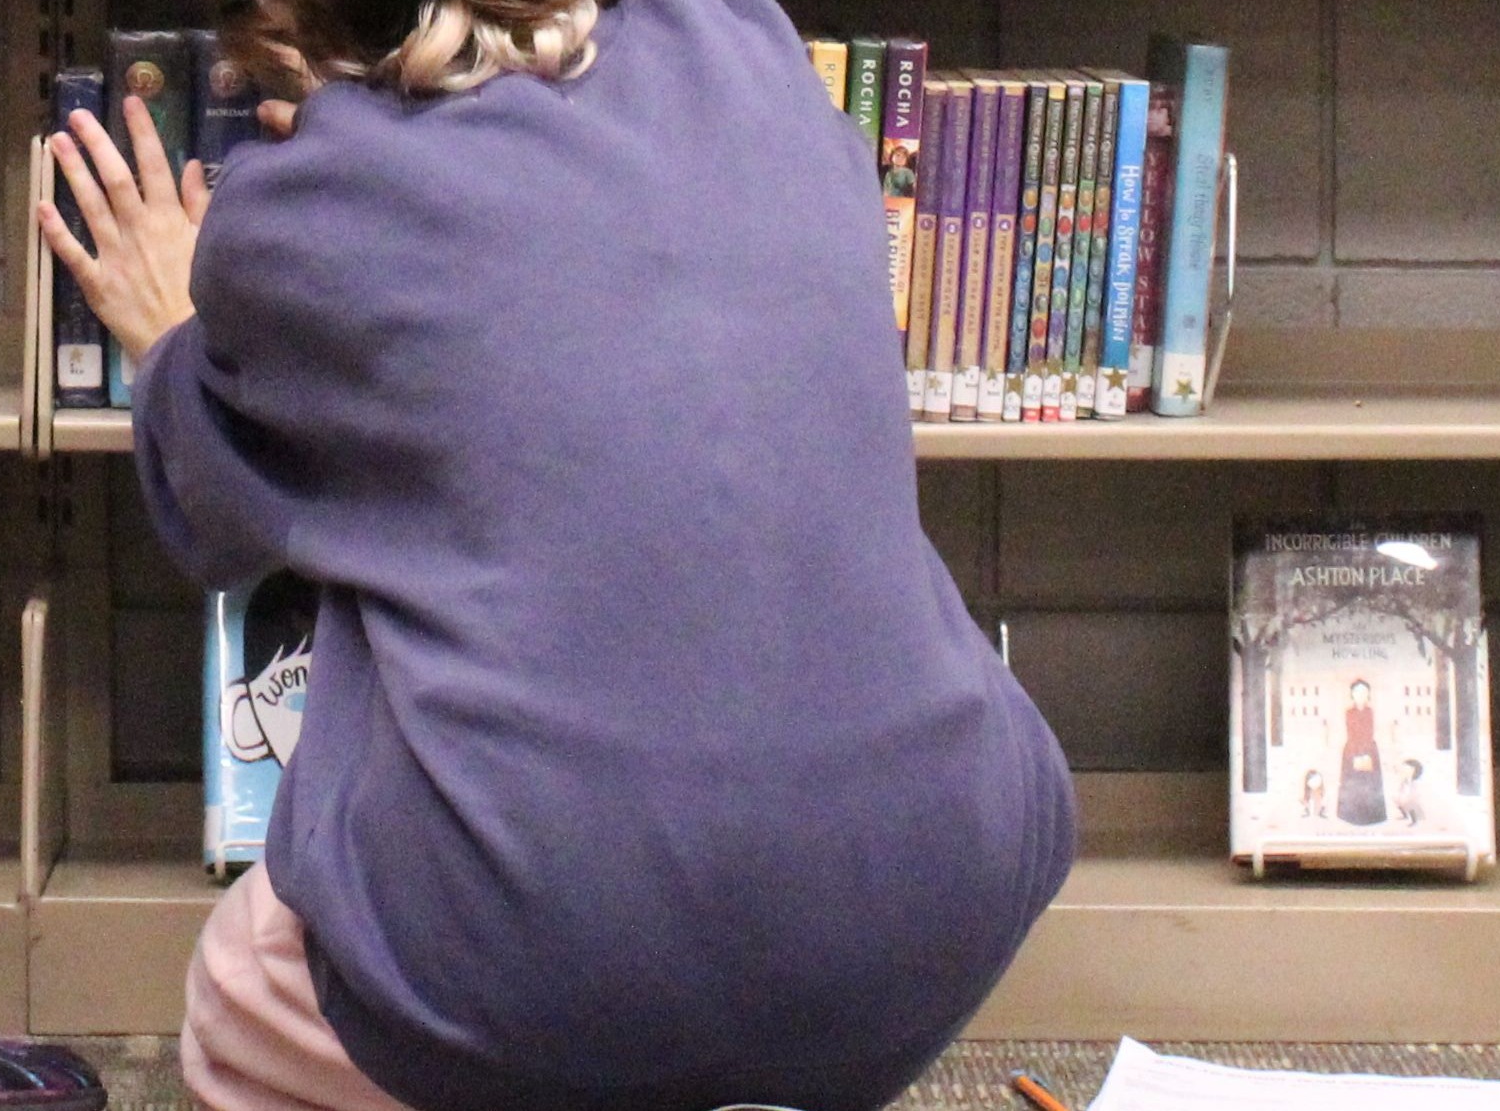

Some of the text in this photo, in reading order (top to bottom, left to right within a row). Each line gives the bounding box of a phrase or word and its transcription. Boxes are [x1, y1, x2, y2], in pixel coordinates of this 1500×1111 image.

[859, 59, 876, 126] ROCHA
[896, 60, 914, 127] ROCHA
[1293, 564, 1426, 587] ASHTON PLACE
